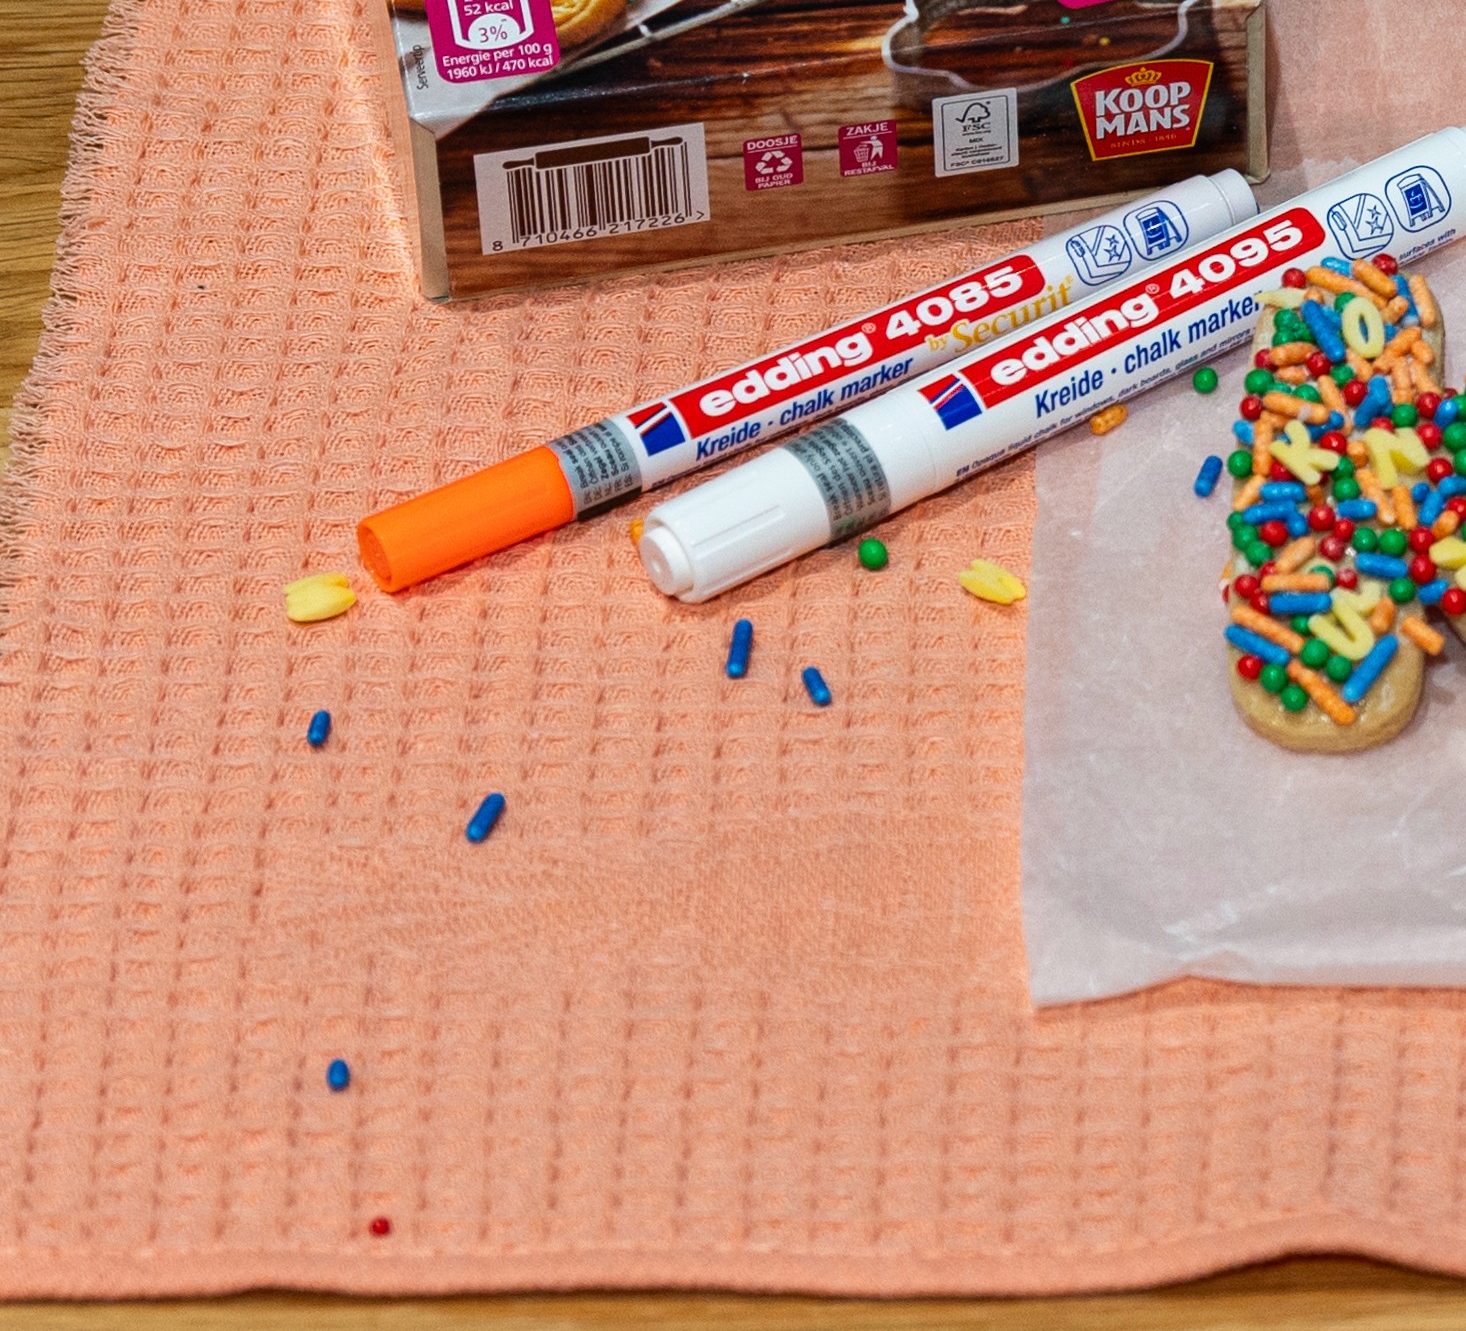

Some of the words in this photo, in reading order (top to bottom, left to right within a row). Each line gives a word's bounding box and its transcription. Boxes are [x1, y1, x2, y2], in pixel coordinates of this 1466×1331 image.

[463, 2, 483, 16] 52
[485, 0, 514, 14] kcal
[478, 23, 508, 44] 3%
[442, 51, 491, 68] Energie
[493, 46, 514, 62] per
[517, 41, 541, 56] 100
[543, 42, 554, 55] g
[446, 63, 477, 81] 1960
[479, 61, 493, 77] kJ
[502, 58, 526, 72] 470
[528, 54, 554, 69] kcal
[1095, 81, 1191, 117] KOOP
[846, 122, 889, 137] ZAKJE
[961, 122, 991, 132] FSC
[1095, 104, 1191, 140] MANS
[747, 135, 798, 150] DOOSJE
[757, 179, 791, 189] PAPIER
[492, 240, 504, 252] 8
[520, 225, 598, 248] 710466
[608, 213, 686, 236] 217226
[1169, 219, 1304, 300] 4095
[885, 265, 1027, 341] 4085
[924, 332, 949, 355] by
[1034, 369, 1104, 419] Kreide
[1124, 327, 1182, 375] chalk
[695, 423, 762, 463] Kreide
[779, 391, 836, 426] chalk
[840, 356, 915, 402] marker
